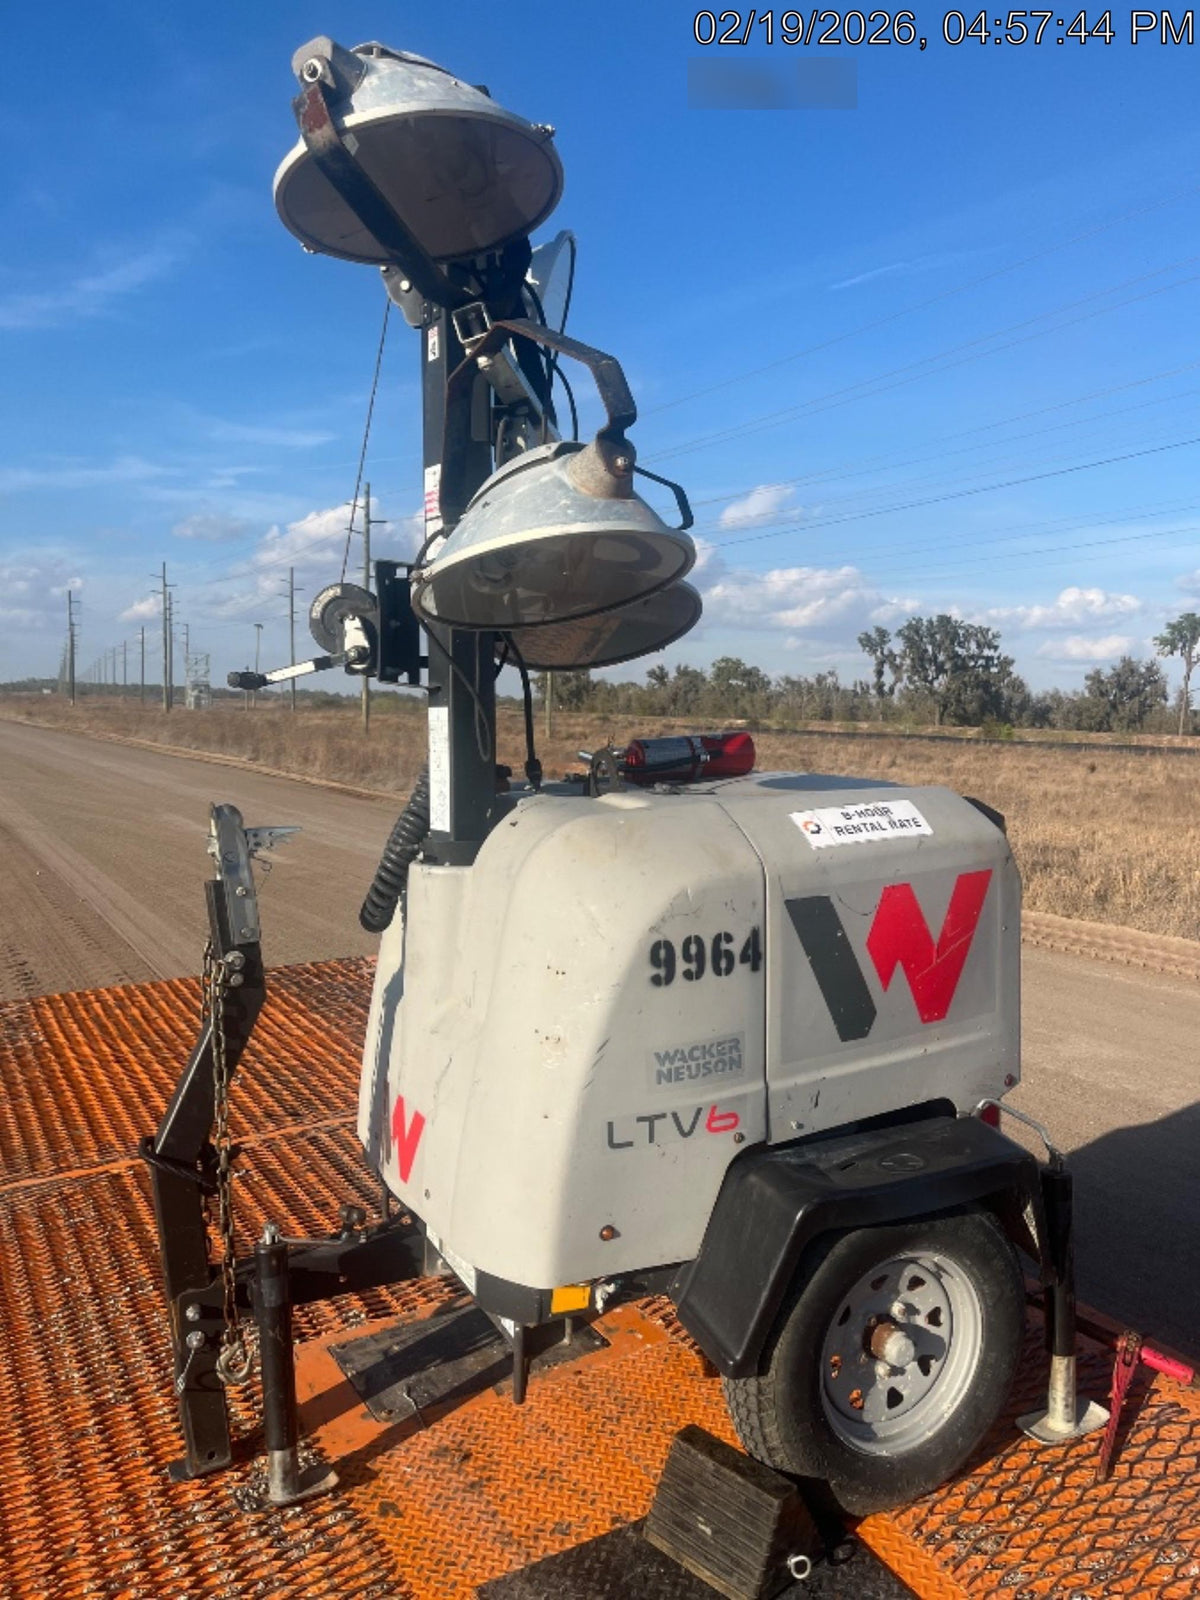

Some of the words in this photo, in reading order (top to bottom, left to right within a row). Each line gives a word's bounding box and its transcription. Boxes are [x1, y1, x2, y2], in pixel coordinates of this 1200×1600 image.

[833, 821, 888, 836] RENTAL
[888, 817, 922, 830] RATE
[649, 925, 762, 987] 9964
[654, 1038, 740, 1067] WACKER
[656, 1054, 742, 1085] NEUSON
[607, 1104, 740, 1149] LTV6
